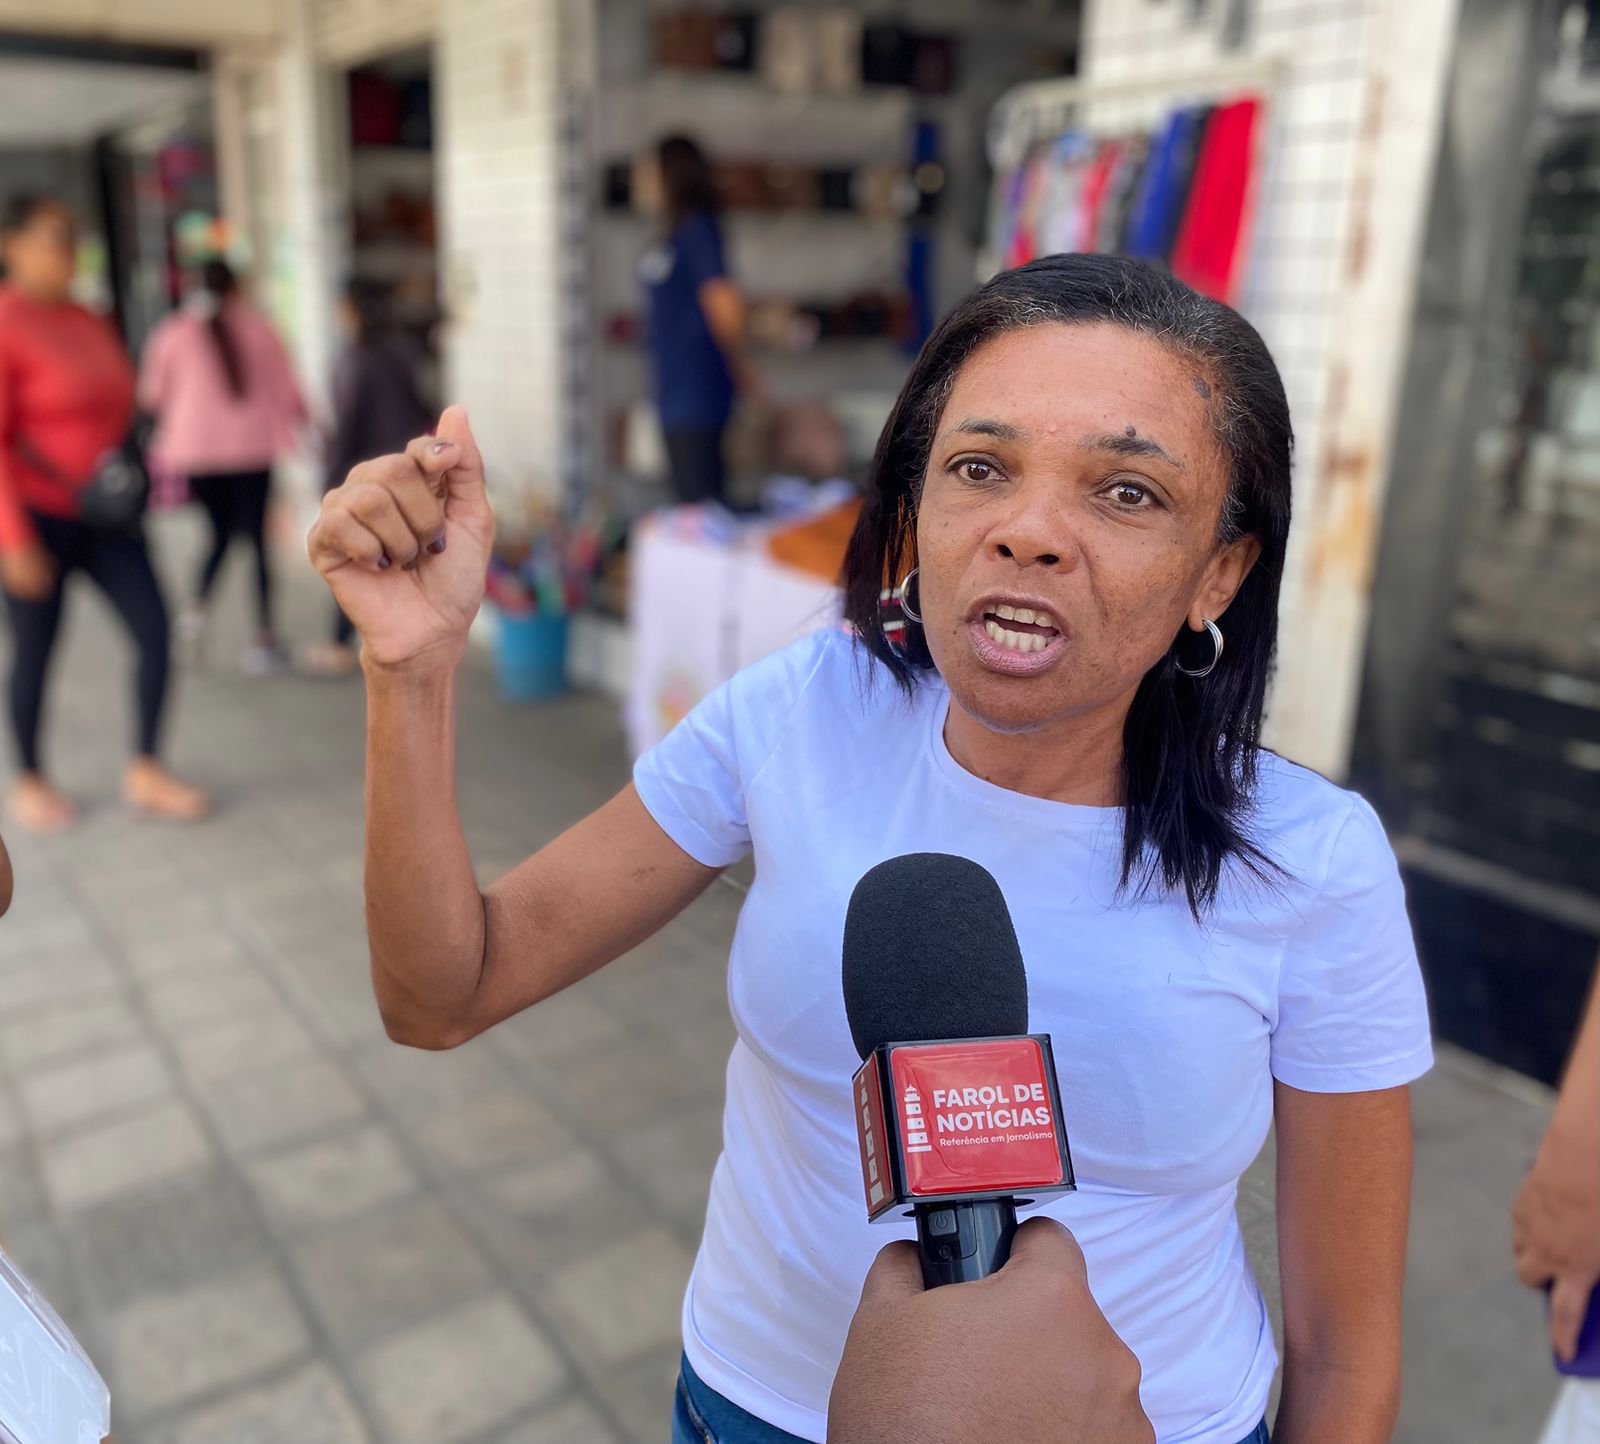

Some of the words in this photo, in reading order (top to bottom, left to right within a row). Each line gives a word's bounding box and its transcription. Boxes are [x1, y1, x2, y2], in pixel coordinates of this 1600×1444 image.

[933, 1086, 1010, 1108] FAROL
[1013, 1083, 1045, 1103] DE
[936, 1105, 1051, 1133] NOTÍCIAS
[940, 1136, 989, 1147] Referência
[991, 1135, 1005, 1143] em
